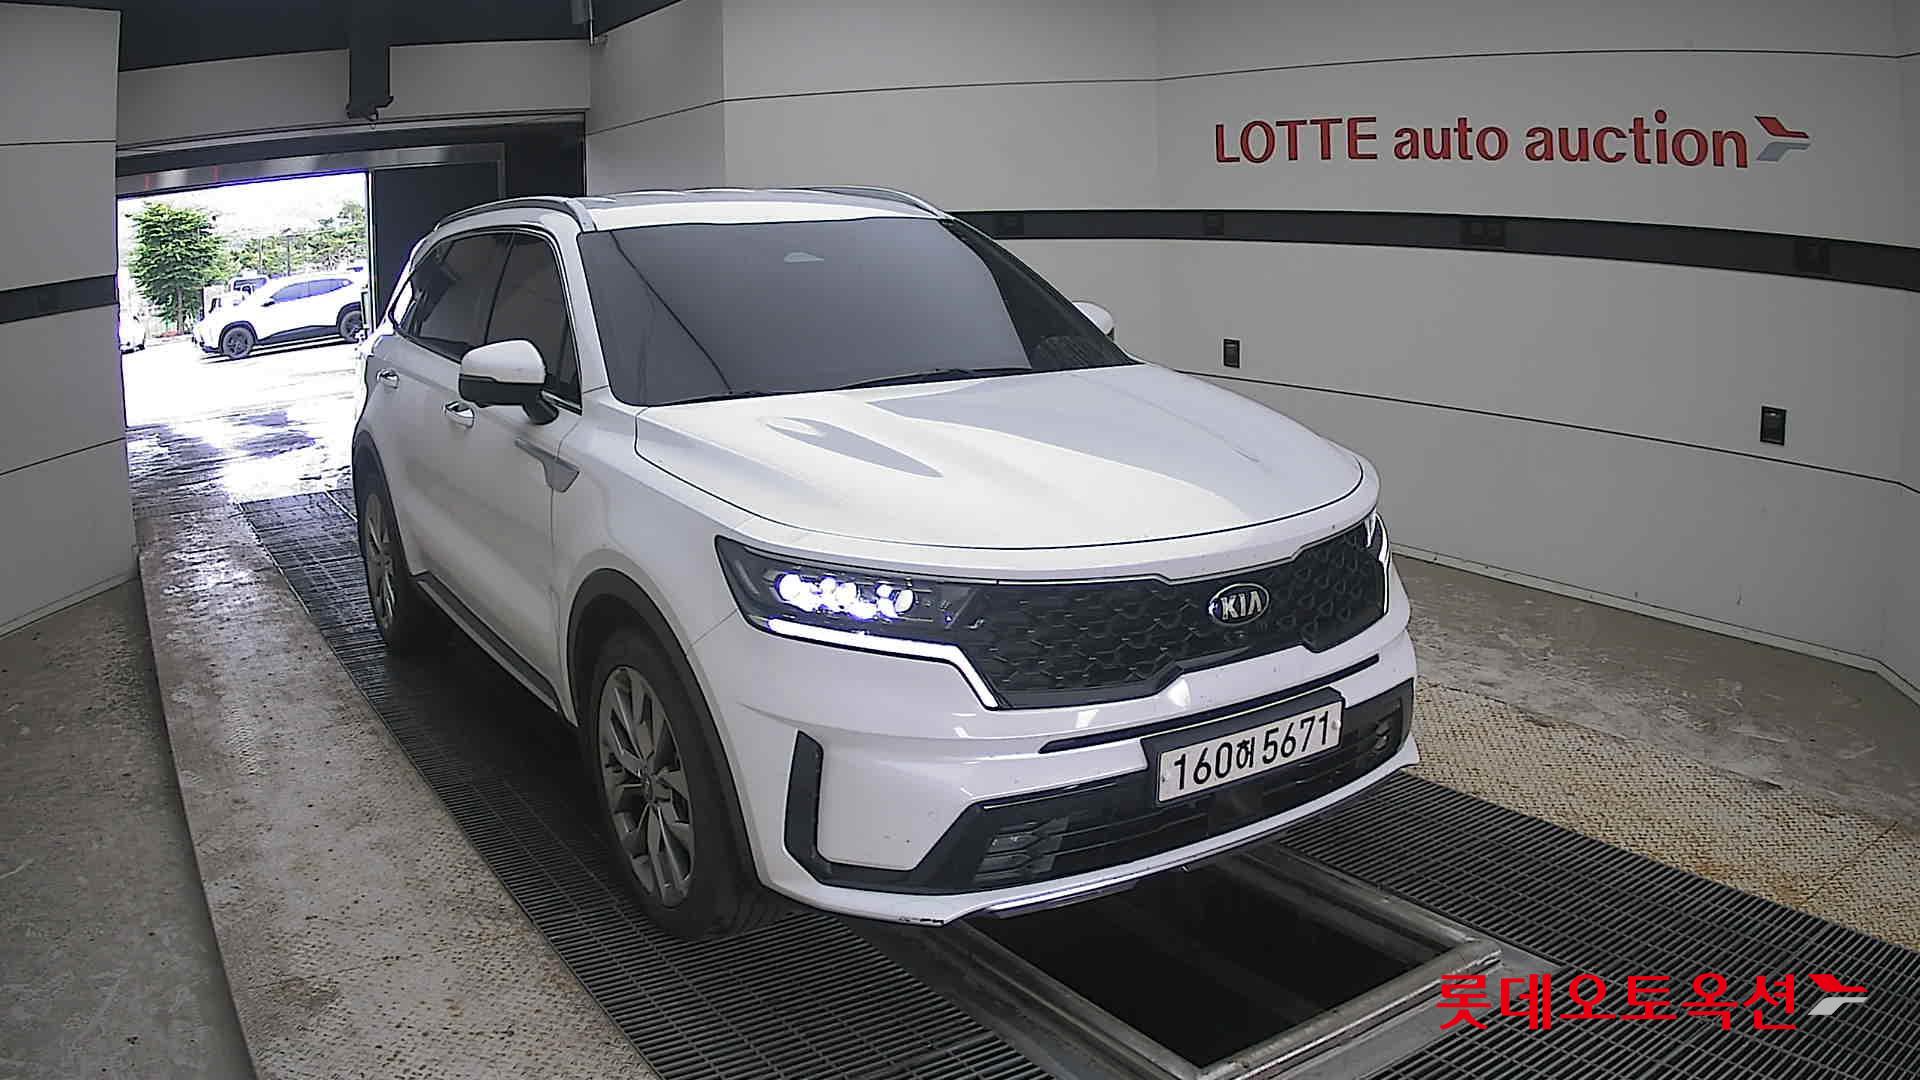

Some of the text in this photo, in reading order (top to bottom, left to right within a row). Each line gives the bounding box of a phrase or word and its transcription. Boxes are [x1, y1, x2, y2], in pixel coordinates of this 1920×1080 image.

[1215, 109, 1748, 169] LOTTE auto auction
[1220, 591, 1262, 620] KIA
[1263, 711, 1330, 764] 5671
